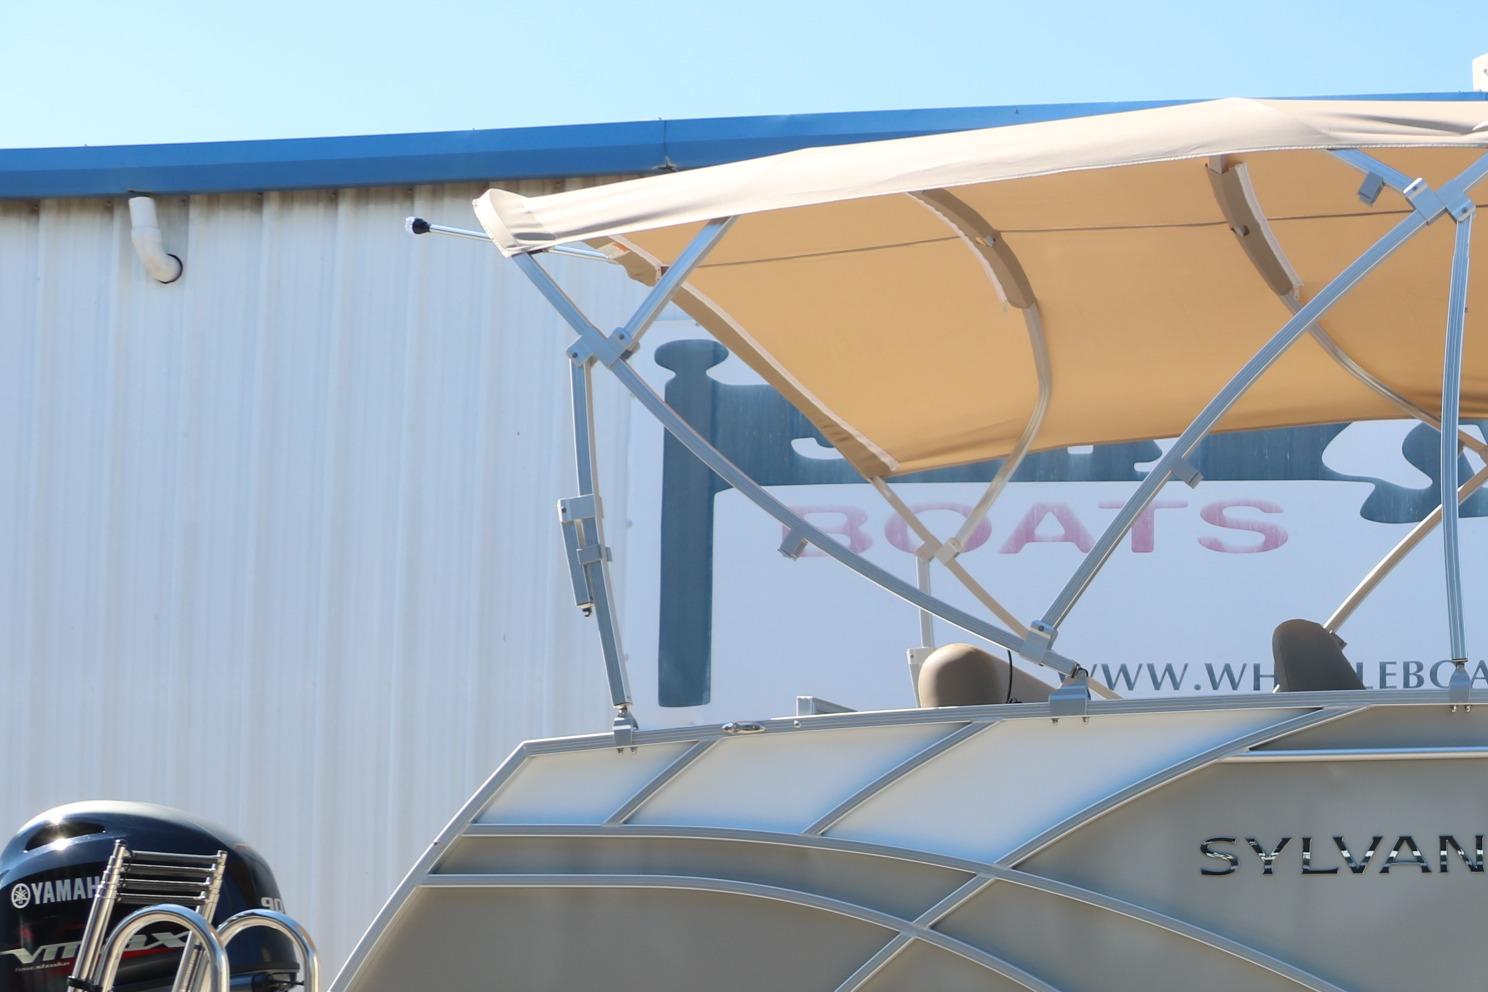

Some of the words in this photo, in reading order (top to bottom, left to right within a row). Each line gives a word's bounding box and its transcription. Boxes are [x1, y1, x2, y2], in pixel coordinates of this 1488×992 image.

[781, 499, 1289, 557] BOATS
[1200, 835, 1485, 875] SYLVAN
[31, 875, 101, 905] YAMAH
